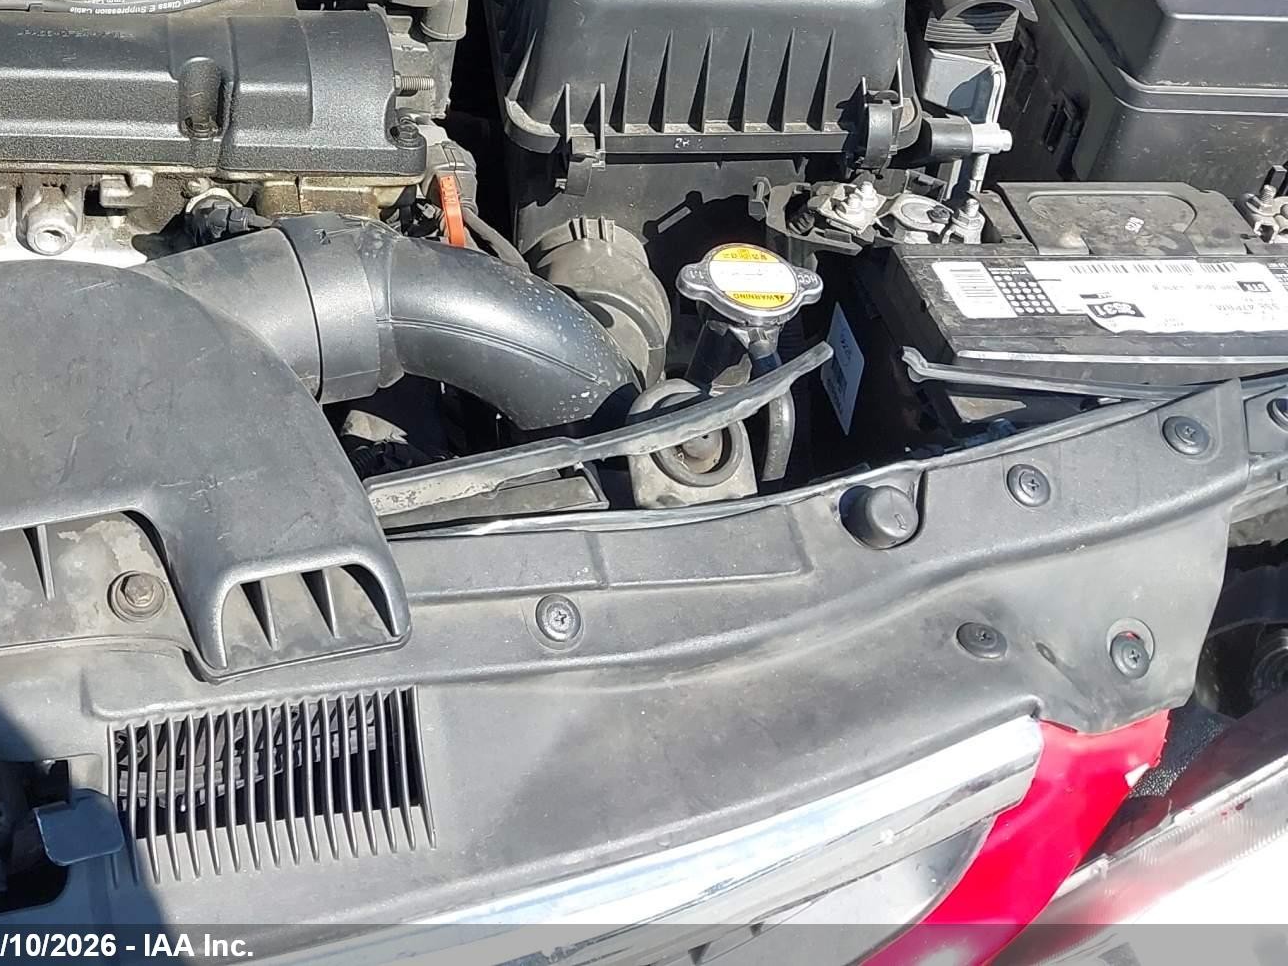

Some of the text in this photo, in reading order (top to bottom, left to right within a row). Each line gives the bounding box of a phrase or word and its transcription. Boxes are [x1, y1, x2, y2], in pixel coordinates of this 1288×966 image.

[95, 5, 147, 15] Suppression
[149, 4, 156, 13] E
[158, 0, 182, 11] Class
[797, 274, 818, 284] HCC
[733, 293, 775, 302] WARNING
